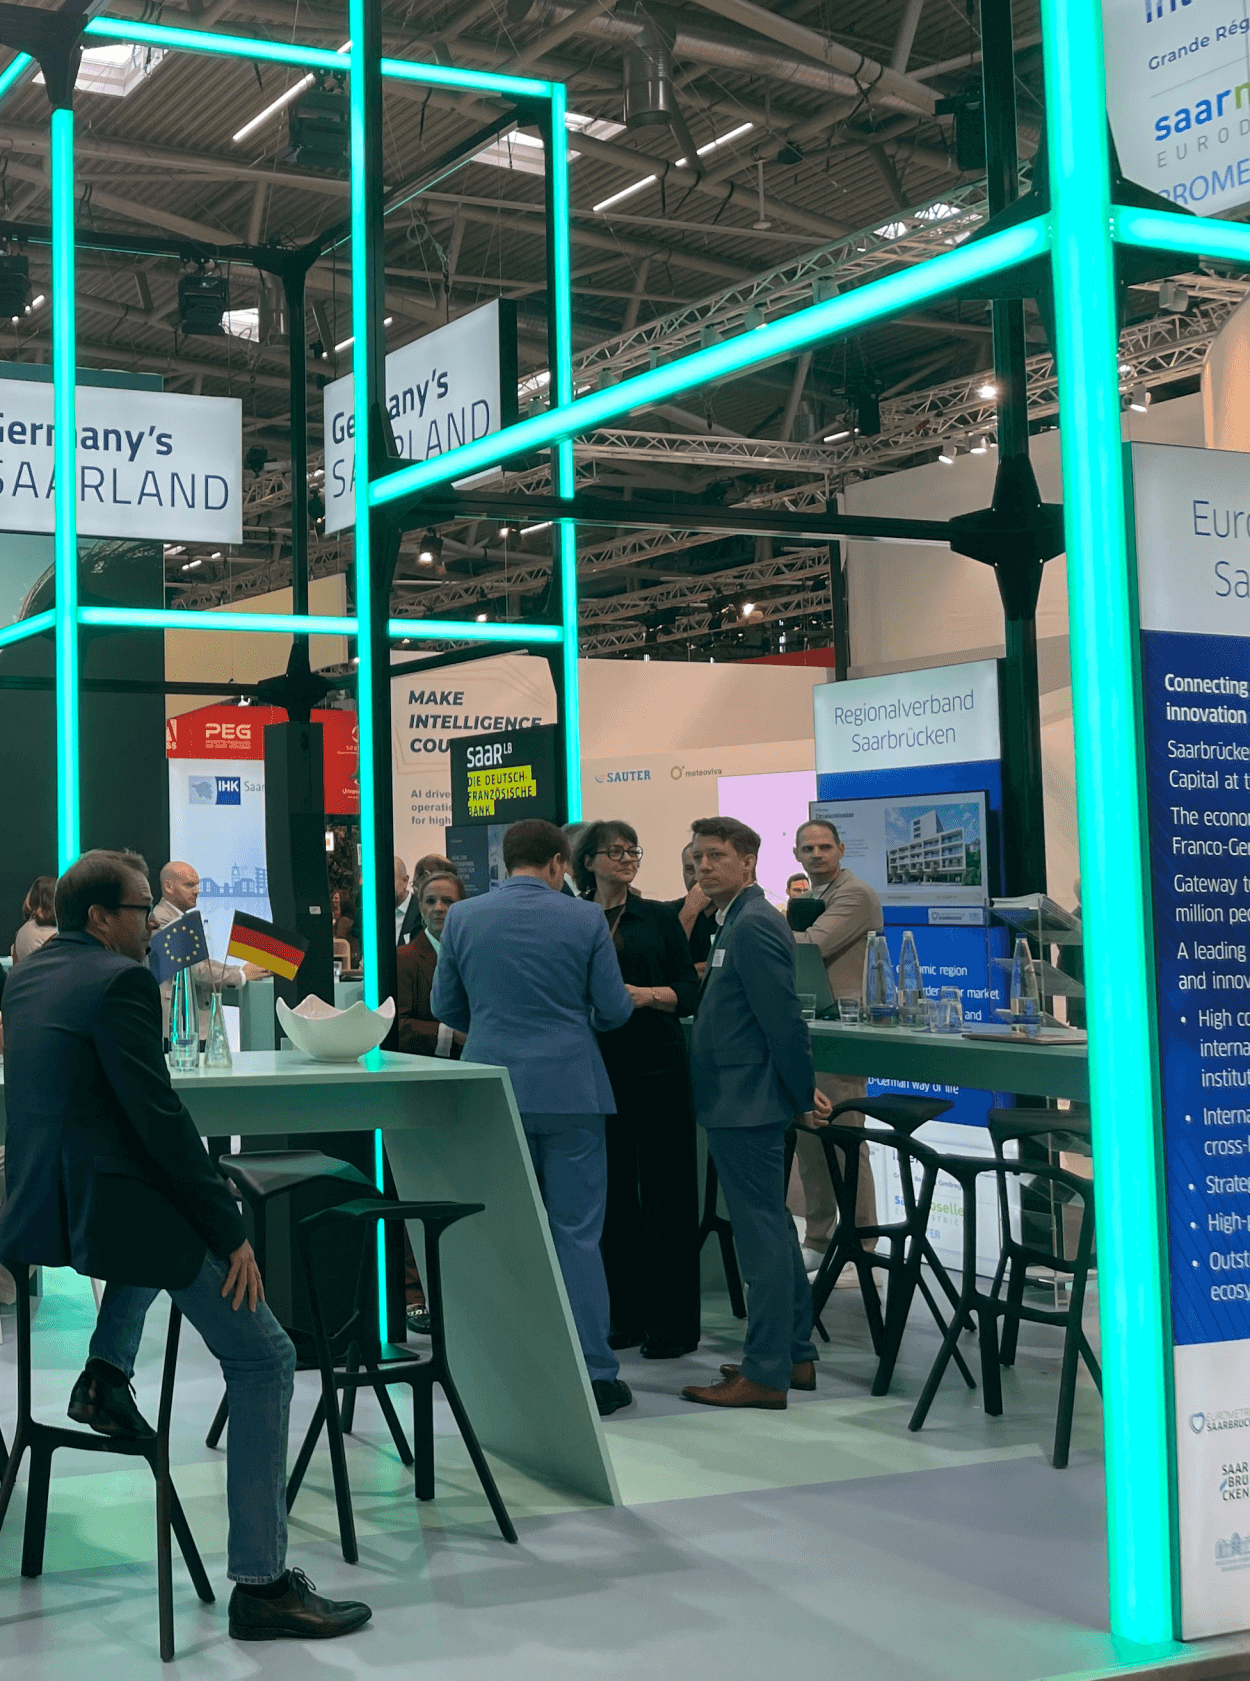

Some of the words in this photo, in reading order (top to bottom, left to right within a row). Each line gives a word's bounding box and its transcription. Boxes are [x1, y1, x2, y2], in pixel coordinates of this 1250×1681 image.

[1148, 36, 1210, 70] Grande
[332, 368, 449, 445] Geany's
[1164, 673, 1248, 698] Connecting
[408, 690, 464, 706] MAKE
[834, 689, 975, 727] Regionalverband
[1166, 702, 1248, 724] innovation
[205, 723, 251, 739] PEG
[851, 726, 956, 753] Saarbrücken
[1167, 739, 1250, 761] Saarbrücke
[218, 780, 240, 792] IHK
[244, 780, 265, 792] Saar
[468, 776, 481, 787] DIE
[606, 770, 651, 783] SAUTER
[1169, 769, 1219, 791] Capital
[1224, 772, 1240, 790] at
[411, 816, 422, 825] for
[468, 805, 490, 817] BANK
[1170, 806, 1199, 826] The
[1203, 811, 1250, 827] econo
[1174, 874, 1238, 896] Gateway
[1175, 902, 1223, 922] million
[1177, 941, 1189, 960] A
[1194, 940, 1247, 963] leading
[939, 964, 968, 978] region
[1178, 970, 1207, 990] and
[967, 987, 1000, 1000] market
[964, 1010, 982, 1021] and
[1198, 1008, 1232, 1031] High
[1204, 1134, 1250, 1156] cross-
[1208, 1211, 1250, 1235] High-
[1222, 1461, 1248, 1476] SAAR
